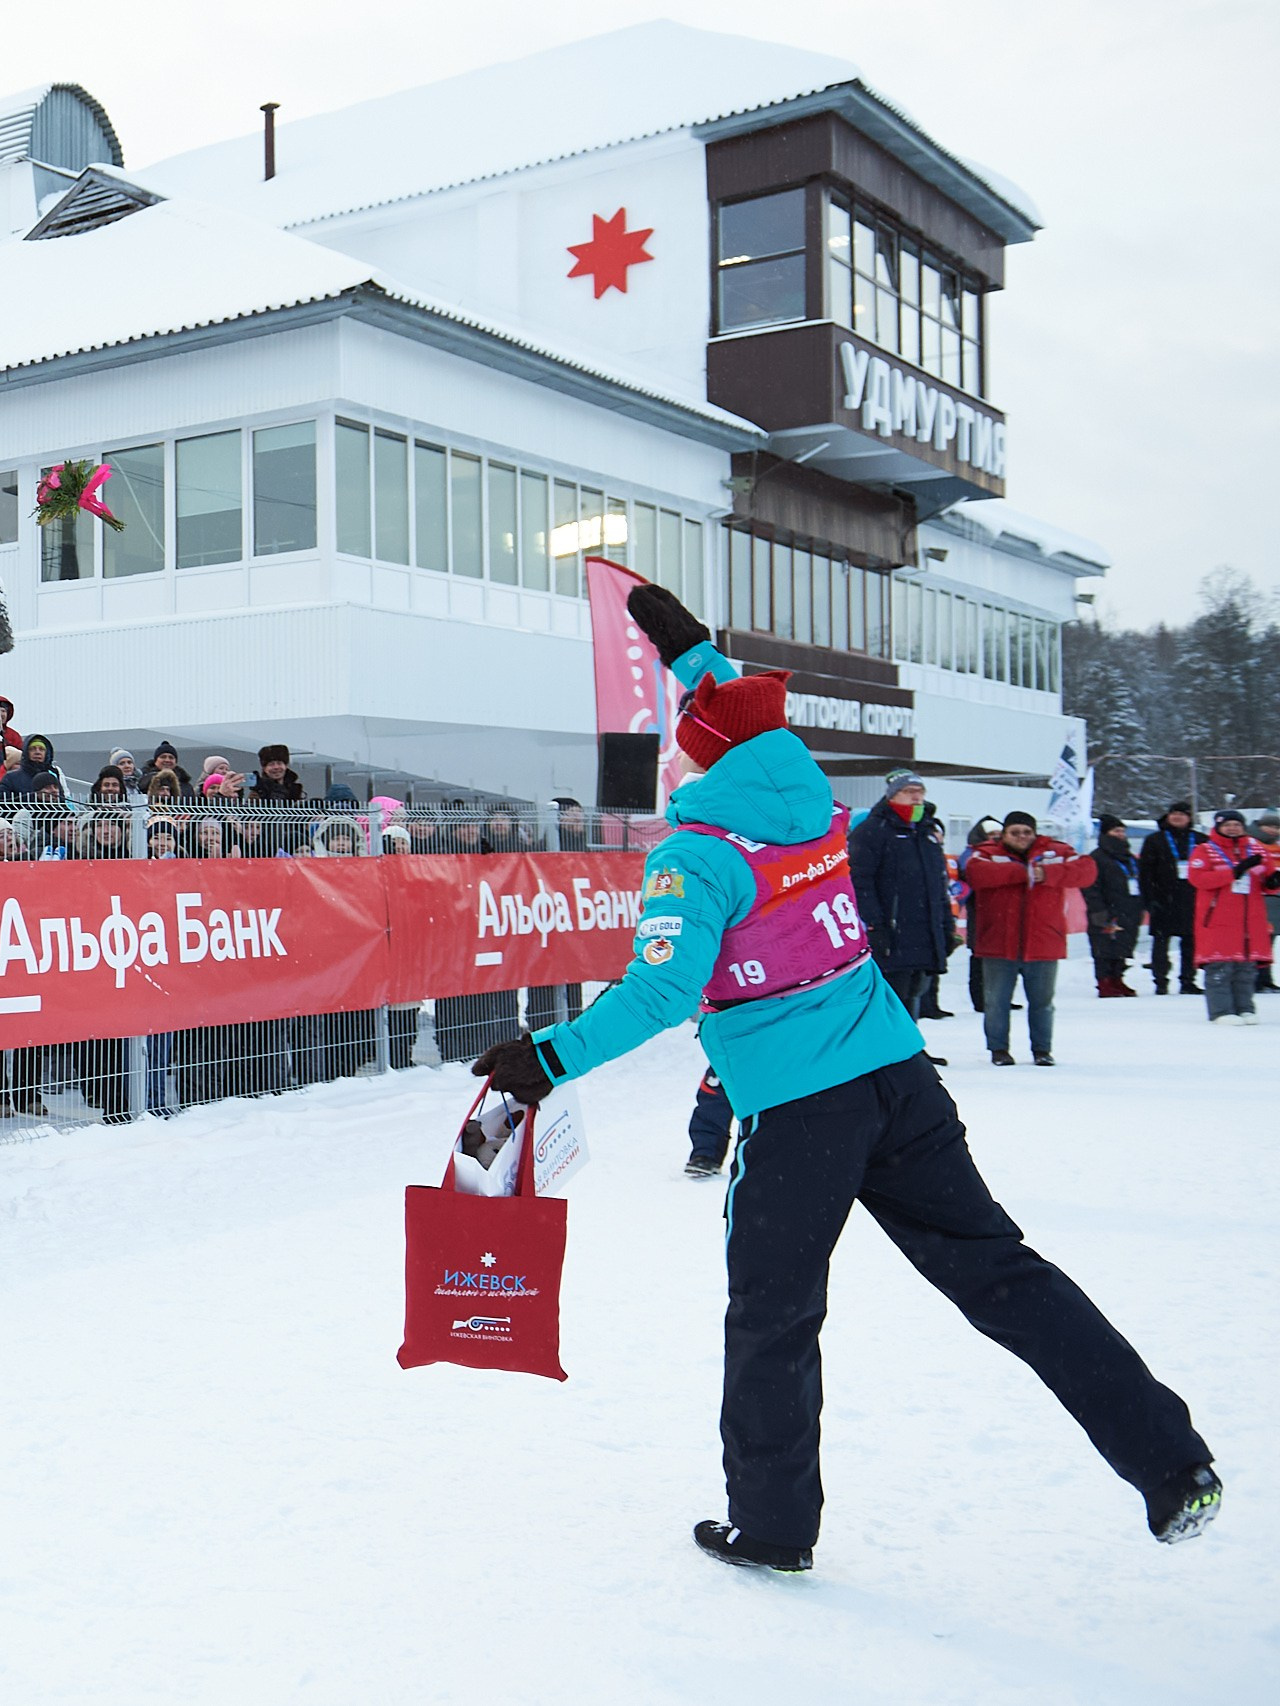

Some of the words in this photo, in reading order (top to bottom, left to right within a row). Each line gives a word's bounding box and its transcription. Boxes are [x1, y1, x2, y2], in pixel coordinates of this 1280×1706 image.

[840, 341, 1005, 479] УДМУРТИЯ
[786, 690, 861, 732] РИТОРИЯ
[175, 893, 287, 963] Банк
[478, 879, 573, 948] Альфа
[572, 877, 642, 931] Банк
[660, 921, 681, 931] GOLD
[812, 892, 861, 948] 19
[728, 959, 767, 987] 19
[444, 1269, 526, 1292] ИЖЕВСК
